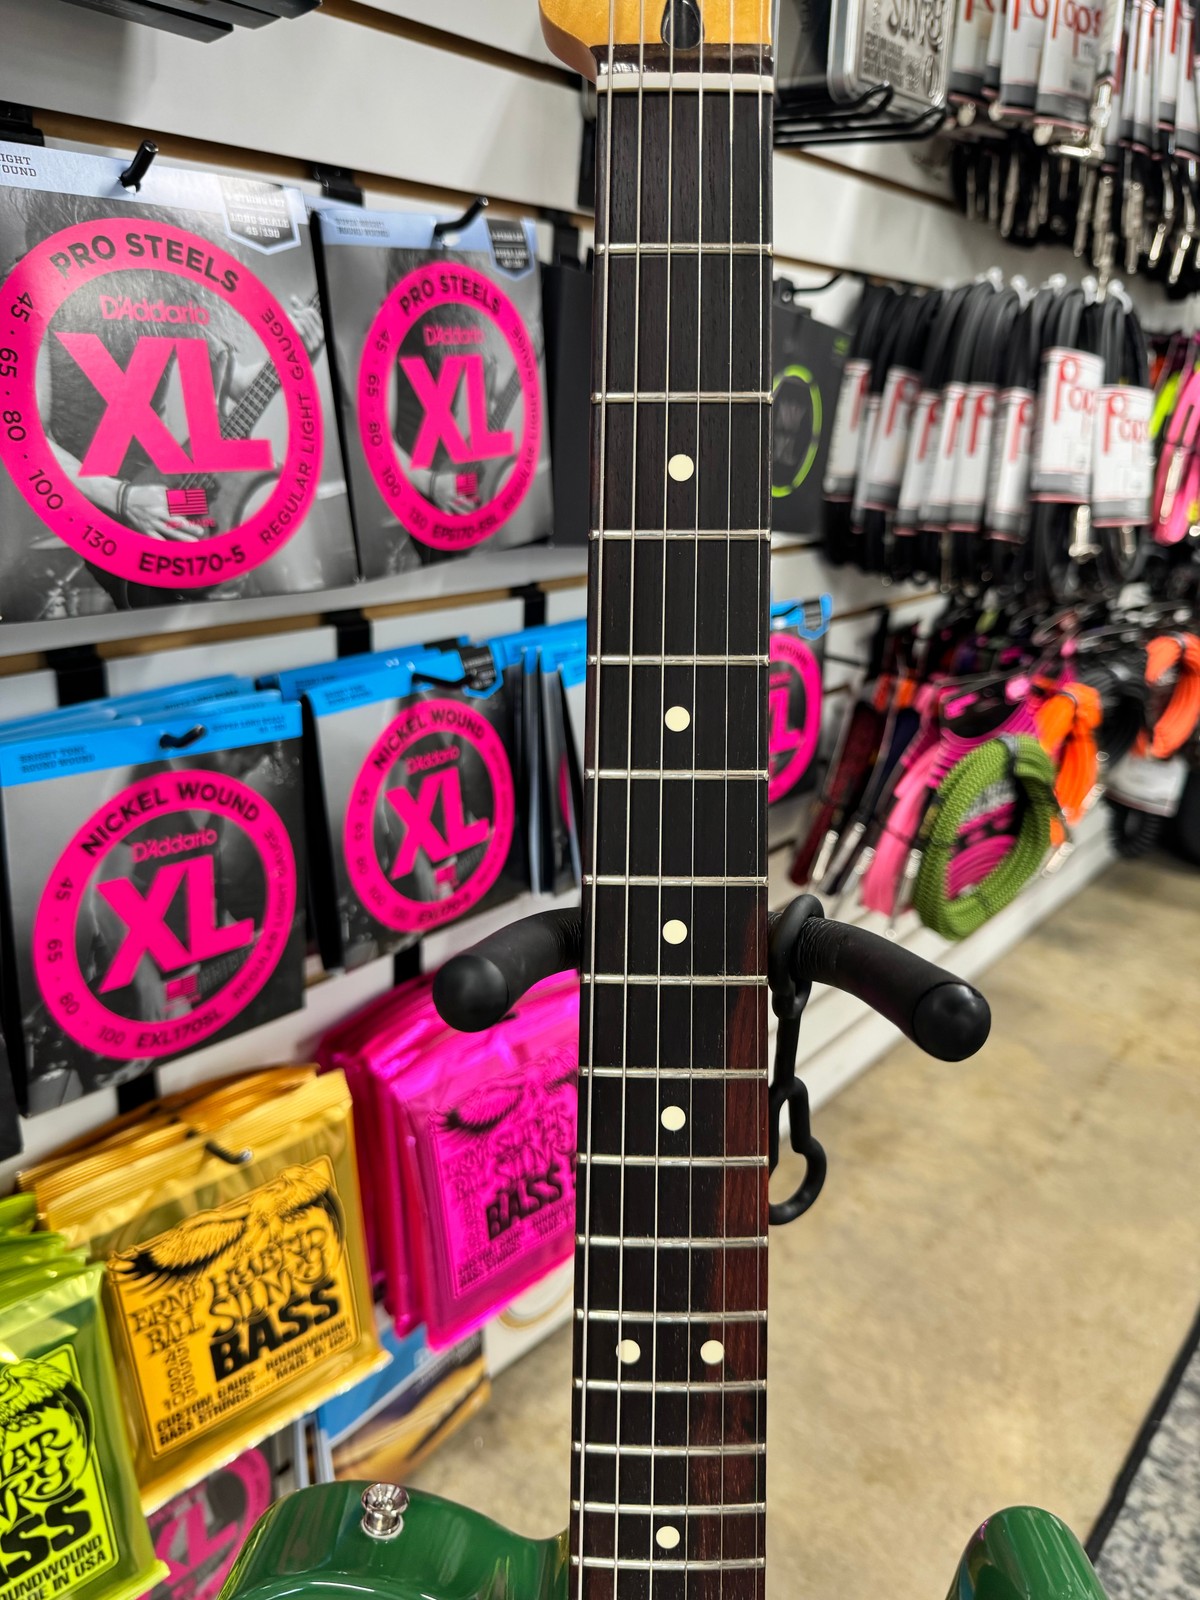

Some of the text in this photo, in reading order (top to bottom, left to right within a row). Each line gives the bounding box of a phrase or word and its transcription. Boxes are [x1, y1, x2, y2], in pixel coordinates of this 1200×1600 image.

[0, 153, 31, 166] IGHT
[0, 164, 37, 178] OUND
[49, 232, 240, 292] PRO STEELS
[399, 273, 501, 316] PRO STEELS
[100, 294, 210, 326] D'Addario
[0, 291, 316, 577] 45 65 80 100 130 EPS170-5 REGULAR LIGHT GAUGE
[54, 331, 274, 478] XL
[400, 354, 514, 471] XL
[374, 709, 485, 770] NICKEL WOUND
[81, 782, 260, 857] NICKEL WOUND
[131, 827, 217, 863] D'Addario
[385, 766, 490, 881] XL
[96, 854, 254, 994] XL
[47, 938, 63, 963] 65
[97, 1024, 126, 1046] 100
[487, 1162, 562, 1241] BASS
[210, 1280, 341, 1382] BASS
[0, 1487, 92, 1586] SS
[52, 1573, 70, 1591] IN
[75, 1550, 106, 1577] USA
